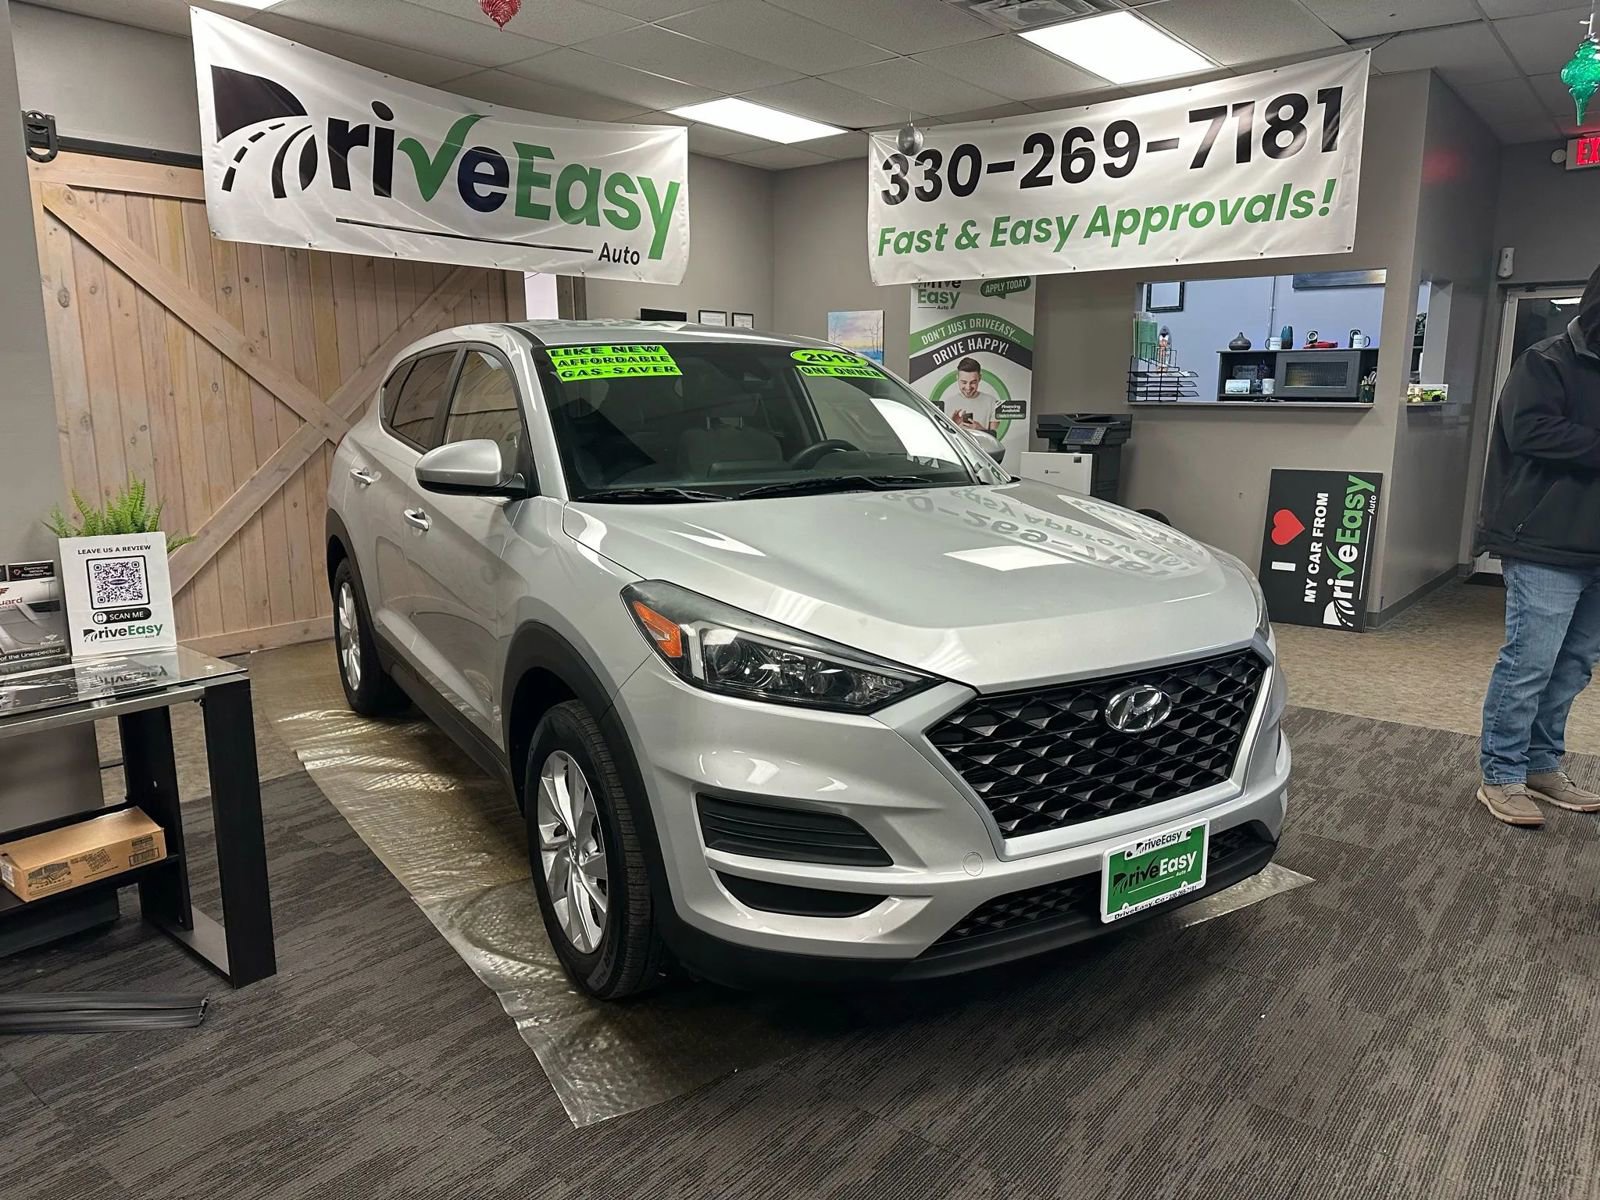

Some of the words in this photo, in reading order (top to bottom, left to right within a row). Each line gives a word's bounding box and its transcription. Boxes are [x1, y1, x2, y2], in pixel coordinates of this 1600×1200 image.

[880, 86, 1344, 206] 330-269-7181
[211, 65, 680, 260] DriveEasy
[877, 223, 949, 257] Fast
[954, 219, 980, 250] &
[990, 212, 1080, 253] Easy
[1083, 178, 1338, 248] Approvals!
[598, 242, 641, 266] Auto
[985, 282, 1005, 294] APPLY
[1006, 278, 1028, 291] TODAY
[917, 289, 960, 310] Easy
[921, 326, 946, 345] DON'T
[947, 320, 968, 335] JUST
[550, 346, 604, 357] LIKE
[611, 345, 661, 354] NEW
[802, 353, 860, 364] 2019
[932, 341, 966, 366] DRIVE
[967, 337, 1009, 355] HAPPY!
[557, 356, 673, 368] AFFORDABLE
[561, 366, 679, 378] GAS-SAVER
[802, 367, 833, 375] ONE
[834, 367, 882, 378] OWNER
[1312, 492, 1329, 537] FROM
[1367, 494, 1377, 515] Auto
[77, 547, 103, 555] LEAVE
[122, 544, 151, 552] REVIEW
[1308, 541, 1323, 574] CAR
[1322, 474, 1376, 627] DriveEasy
[1271, 561, 1296, 572] I
[1304, 578, 1318, 603] MY
[109, 613, 131, 621] SCAN
[83, 624, 163, 643] DriveEasy
[20, 648, 60, 657] Unexpected
[1136, 831, 1183, 854] DriveEasy
[1112, 851, 1198, 896] DriveEasy
